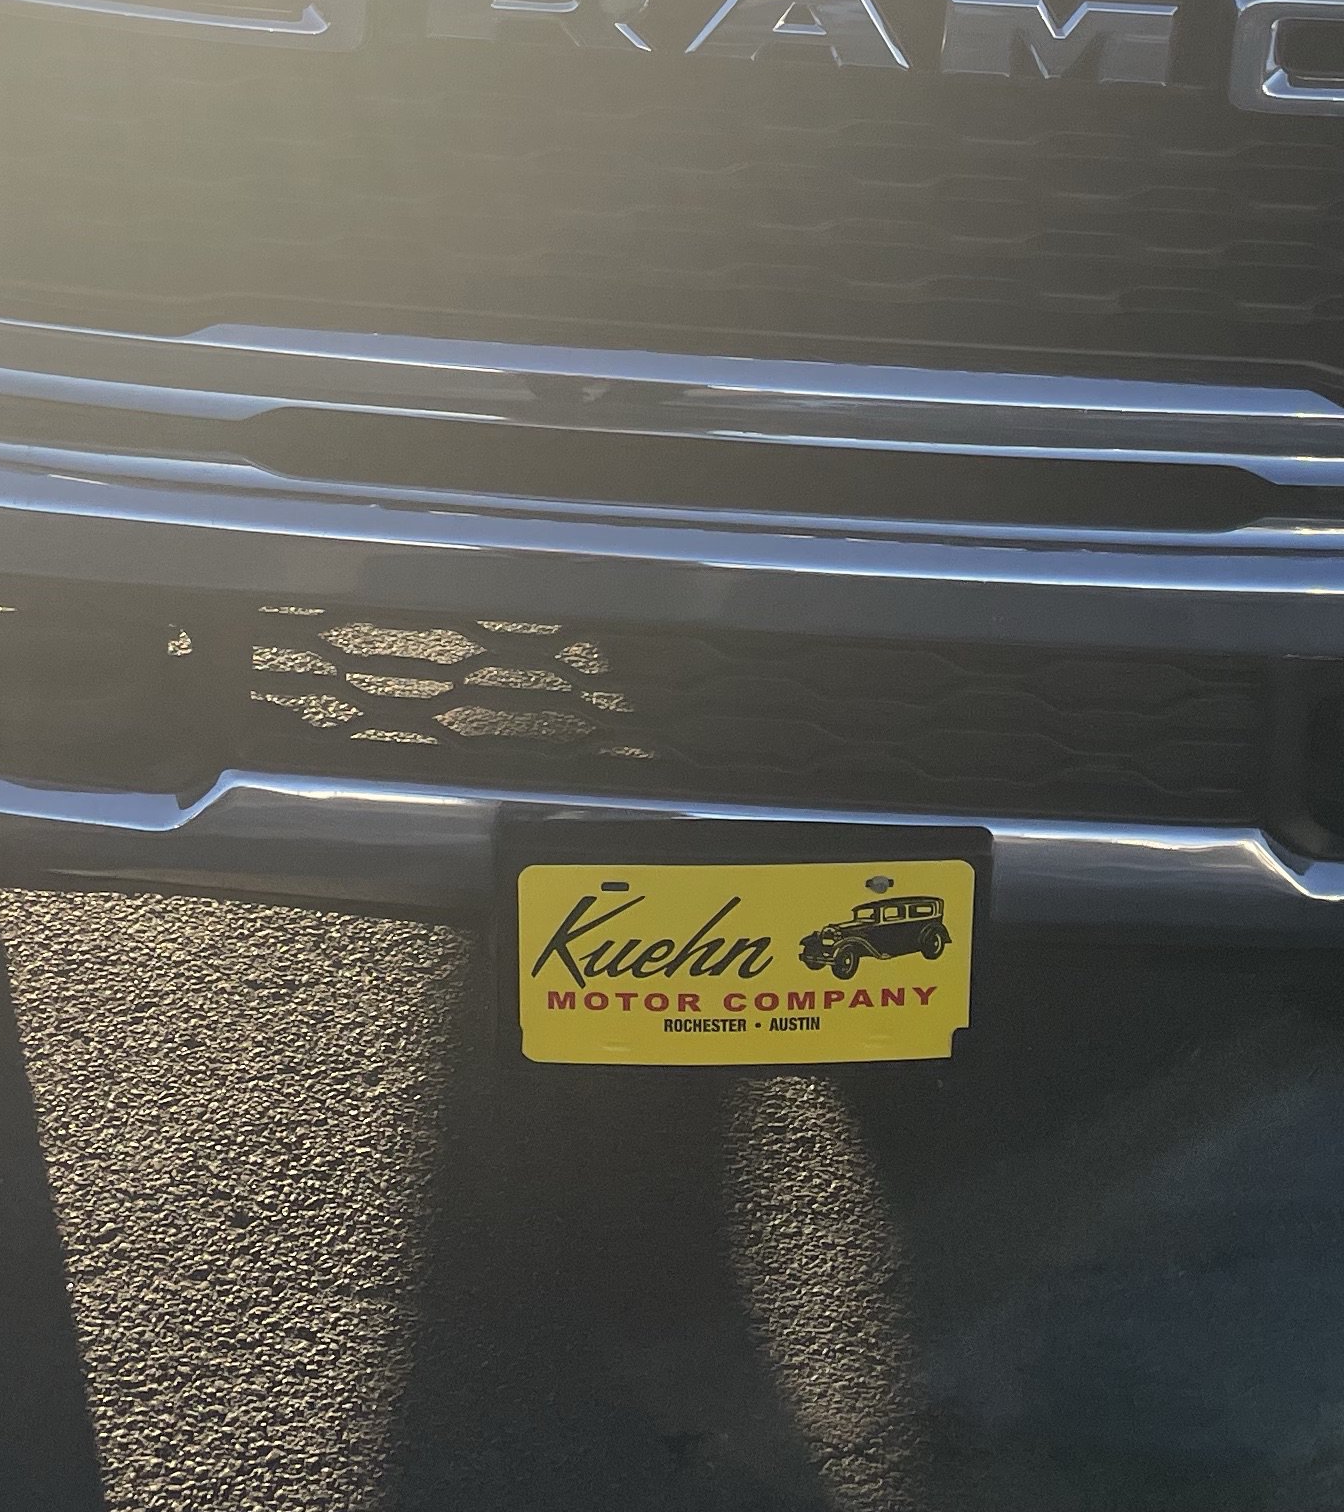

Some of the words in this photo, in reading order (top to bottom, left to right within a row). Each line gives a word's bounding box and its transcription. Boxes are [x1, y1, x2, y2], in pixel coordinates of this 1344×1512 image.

[531, 895, 775, 988] Kuehn
[546, 990, 702, 1013] MOTOR
[722, 986, 938, 1013] COMPANY
[663, 1018, 748, 1034] ROCHESTER
[768, 1016, 821, 1033] AUSTIN
